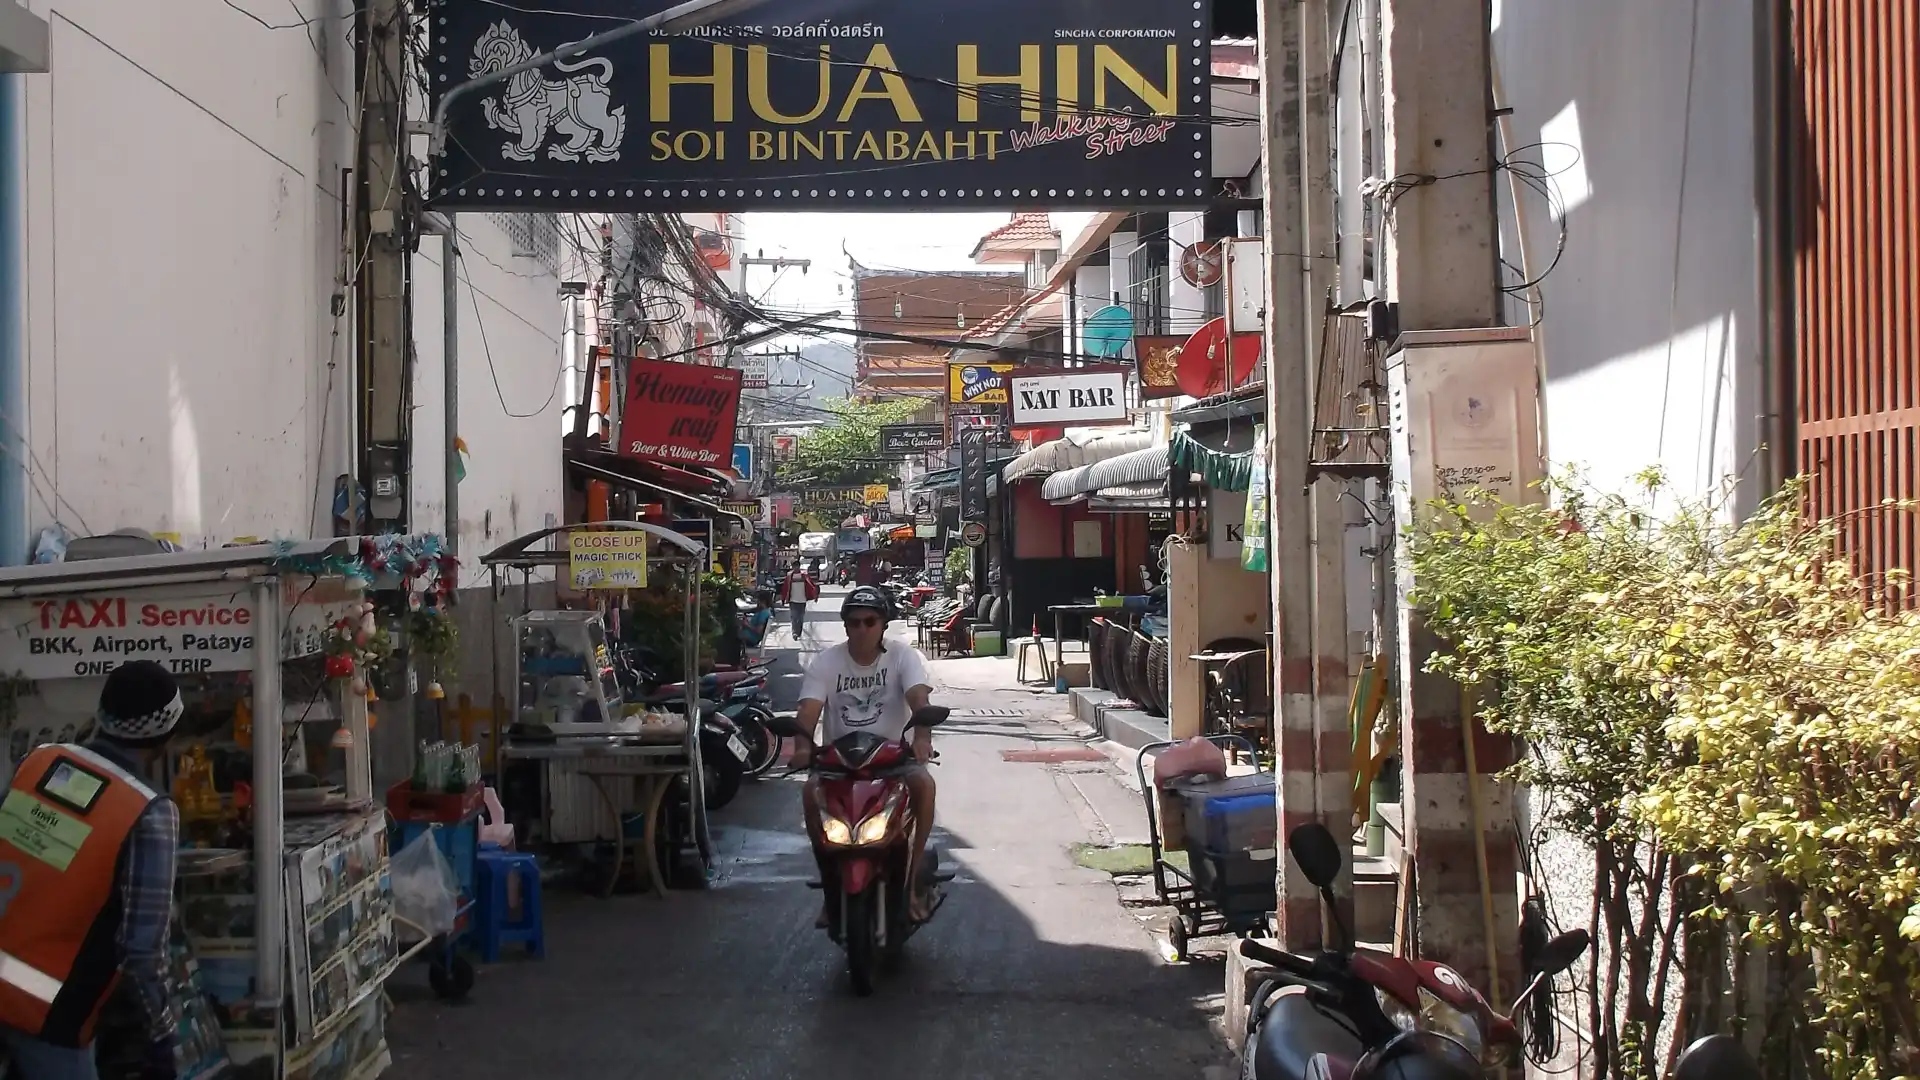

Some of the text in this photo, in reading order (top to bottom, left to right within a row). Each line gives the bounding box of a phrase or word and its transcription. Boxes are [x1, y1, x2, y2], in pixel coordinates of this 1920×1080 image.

[1054, 29, 1176, 38] SINGHA CORPORATION
[649, 43, 1177, 124] HUA HIN
[1010, 105, 1132, 152] Walking
[651, 130, 1003, 161] SOI BINTABAHT
[1085, 119, 1176, 160] Street
[634, 372, 732, 416] Heming
[964, 378, 1001, 399] WHY NOT
[1020, 388, 1116, 410] NAT BAR
[668, 415, 721, 446] way
[632, 441, 720, 462] Beer & Wine Bar
[911, 437, 942, 447] Garden
[804, 489, 836, 501] HUA
[840, 488, 865, 500] HIN
[573, 536, 643, 548] CLOSE UP
[574, 552, 642, 562] MAGIC TRICK
[31, 597, 250, 631] TAXI Service
[30, 637, 83, 655] BKK,
[93, 635, 173, 655] Airport,
[75, 660, 115, 675] ONE
[170, 657, 212, 673] TRIP
